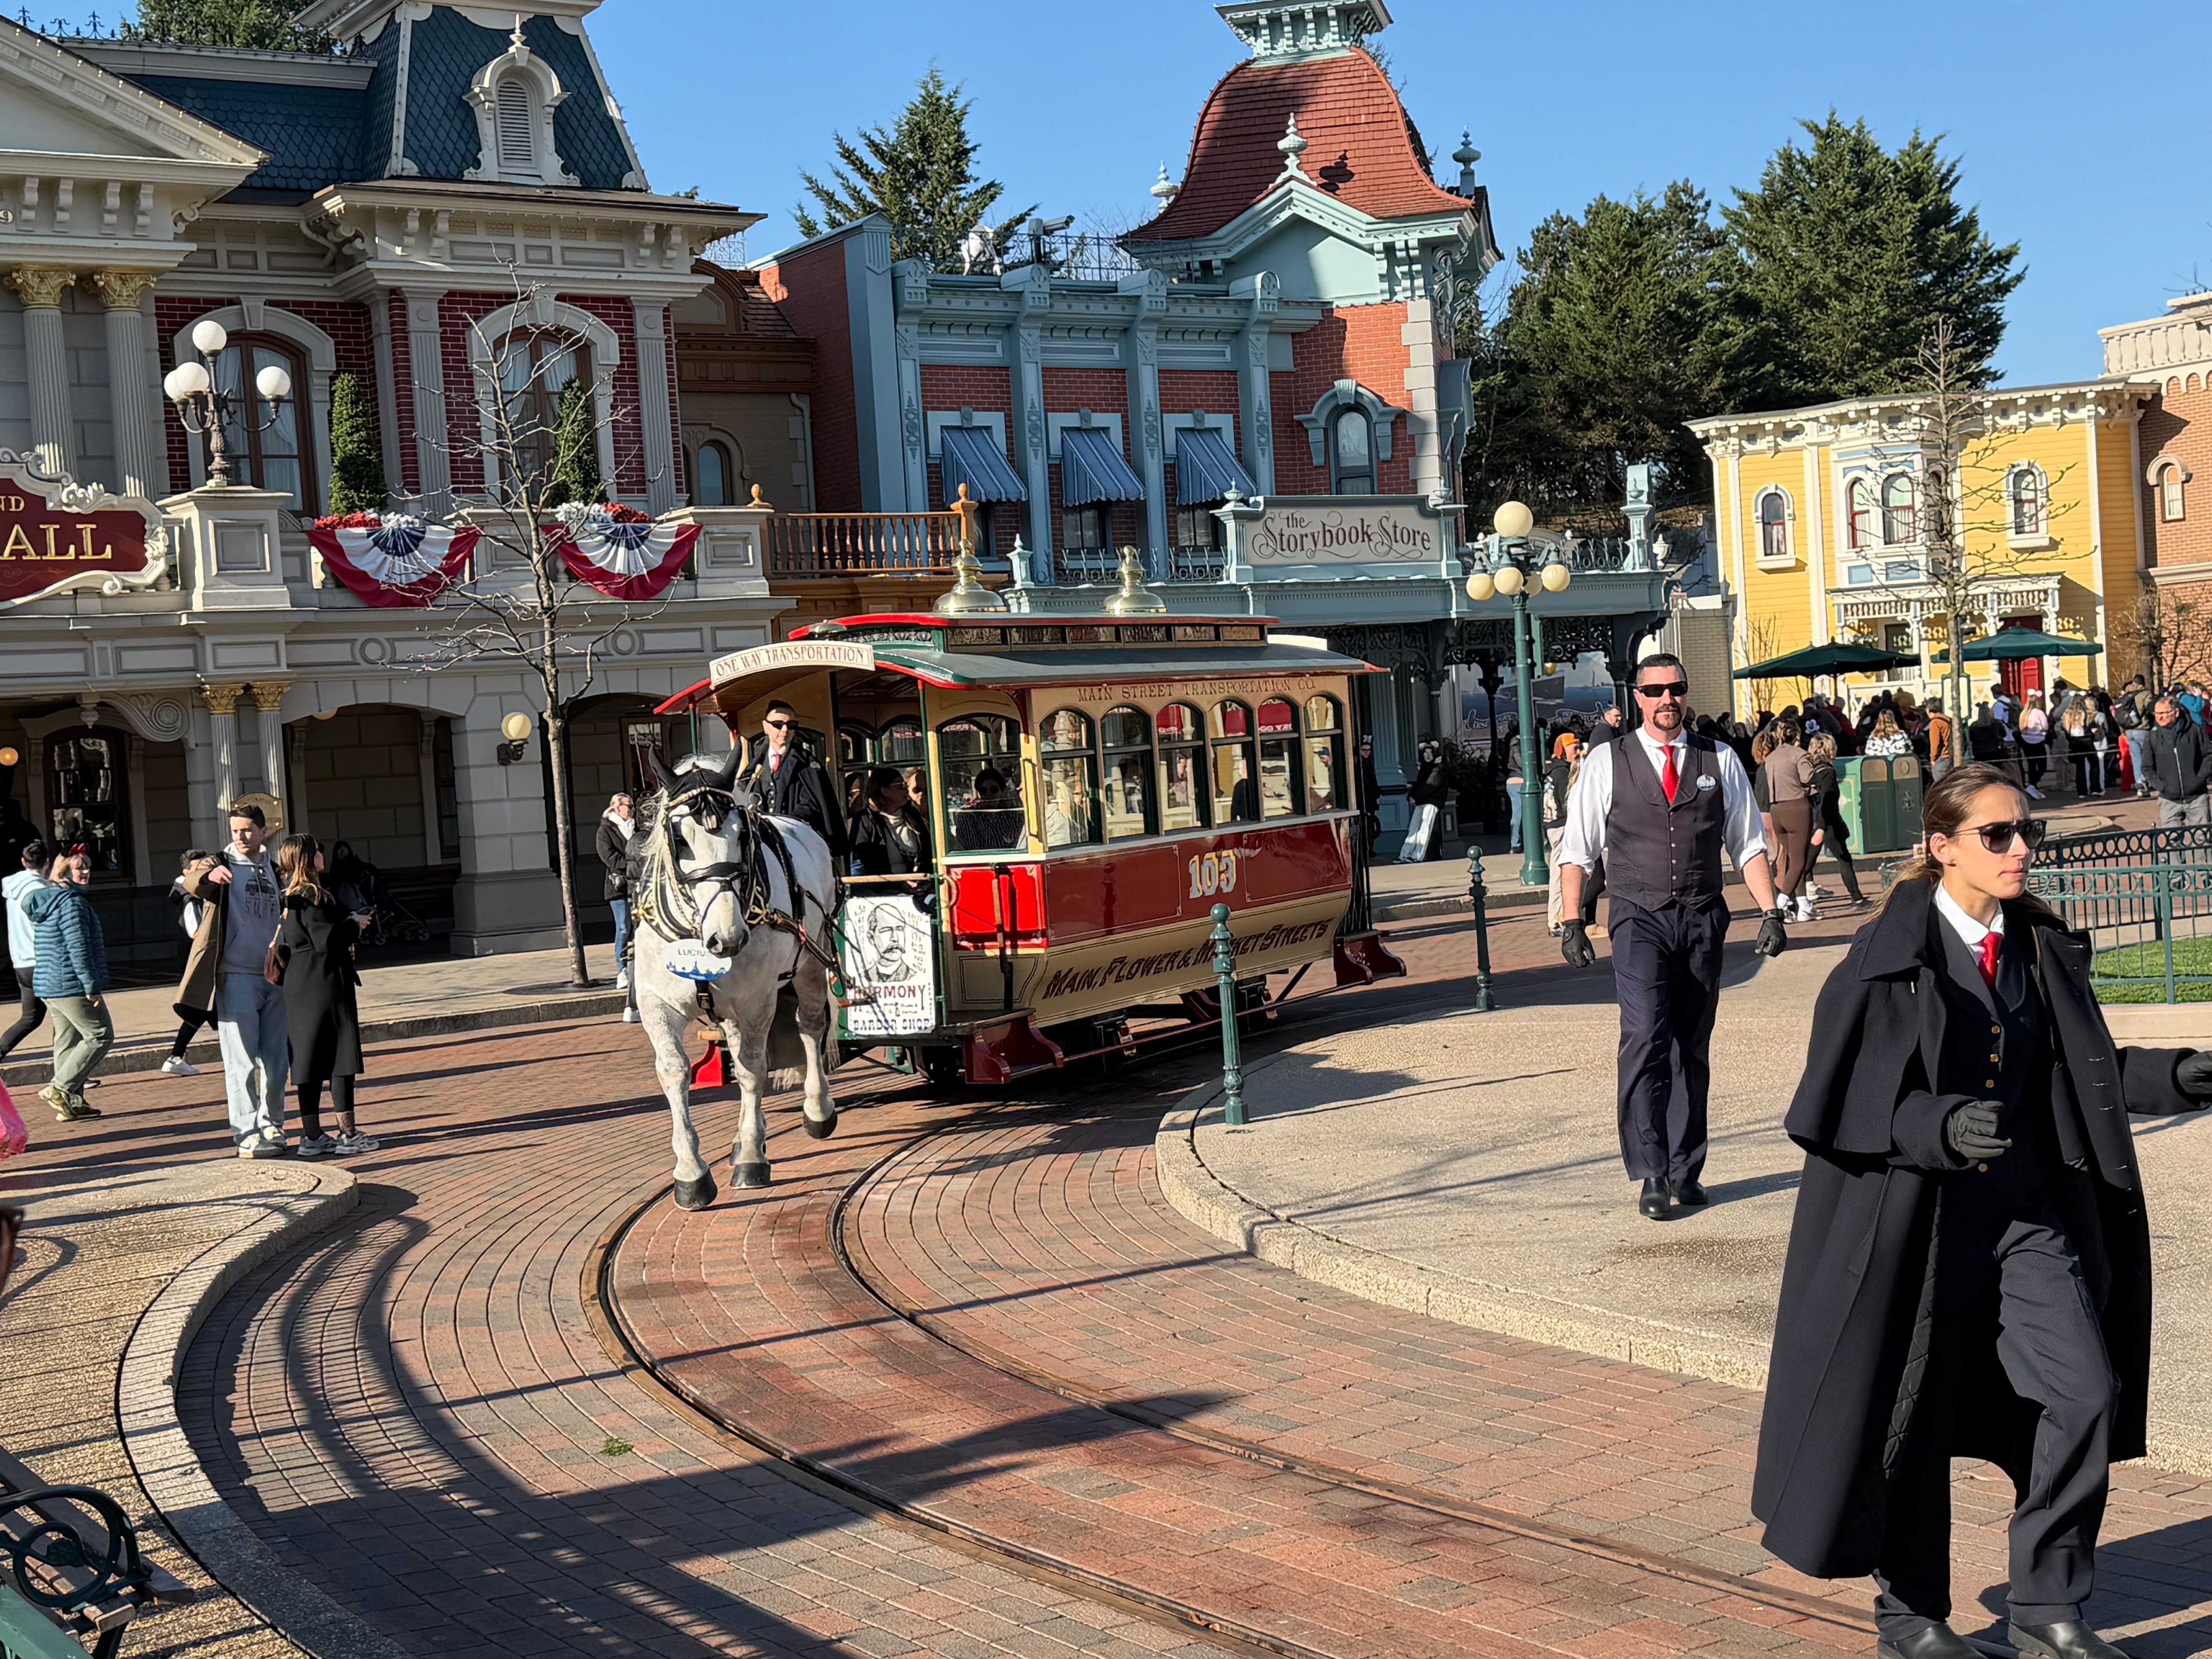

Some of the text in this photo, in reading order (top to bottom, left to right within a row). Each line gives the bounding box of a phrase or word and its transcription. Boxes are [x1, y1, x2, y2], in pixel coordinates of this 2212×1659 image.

[1280, 510, 1312, 529] the
[1252, 511, 1431, 559] Storybook Store
[716, 645, 865, 677] ONE WAY TRANSPORTATION
[1078, 687, 1113, 702] MAIN
[1121, 684, 1173, 699] STREET
[1182, 678, 1291, 696] TRANSPORTATION
[1189, 849, 1237, 899] 103
[1099, 950, 1182, 987] FLOWER
[1177, 948, 1194, 970] &
[1192, 933, 1266, 966] MKET
[1258, 917, 1332, 951] STREETS
[854, 985, 926, 1010] RMONY
[853, 1018, 930, 1031] BARBR SHOP
